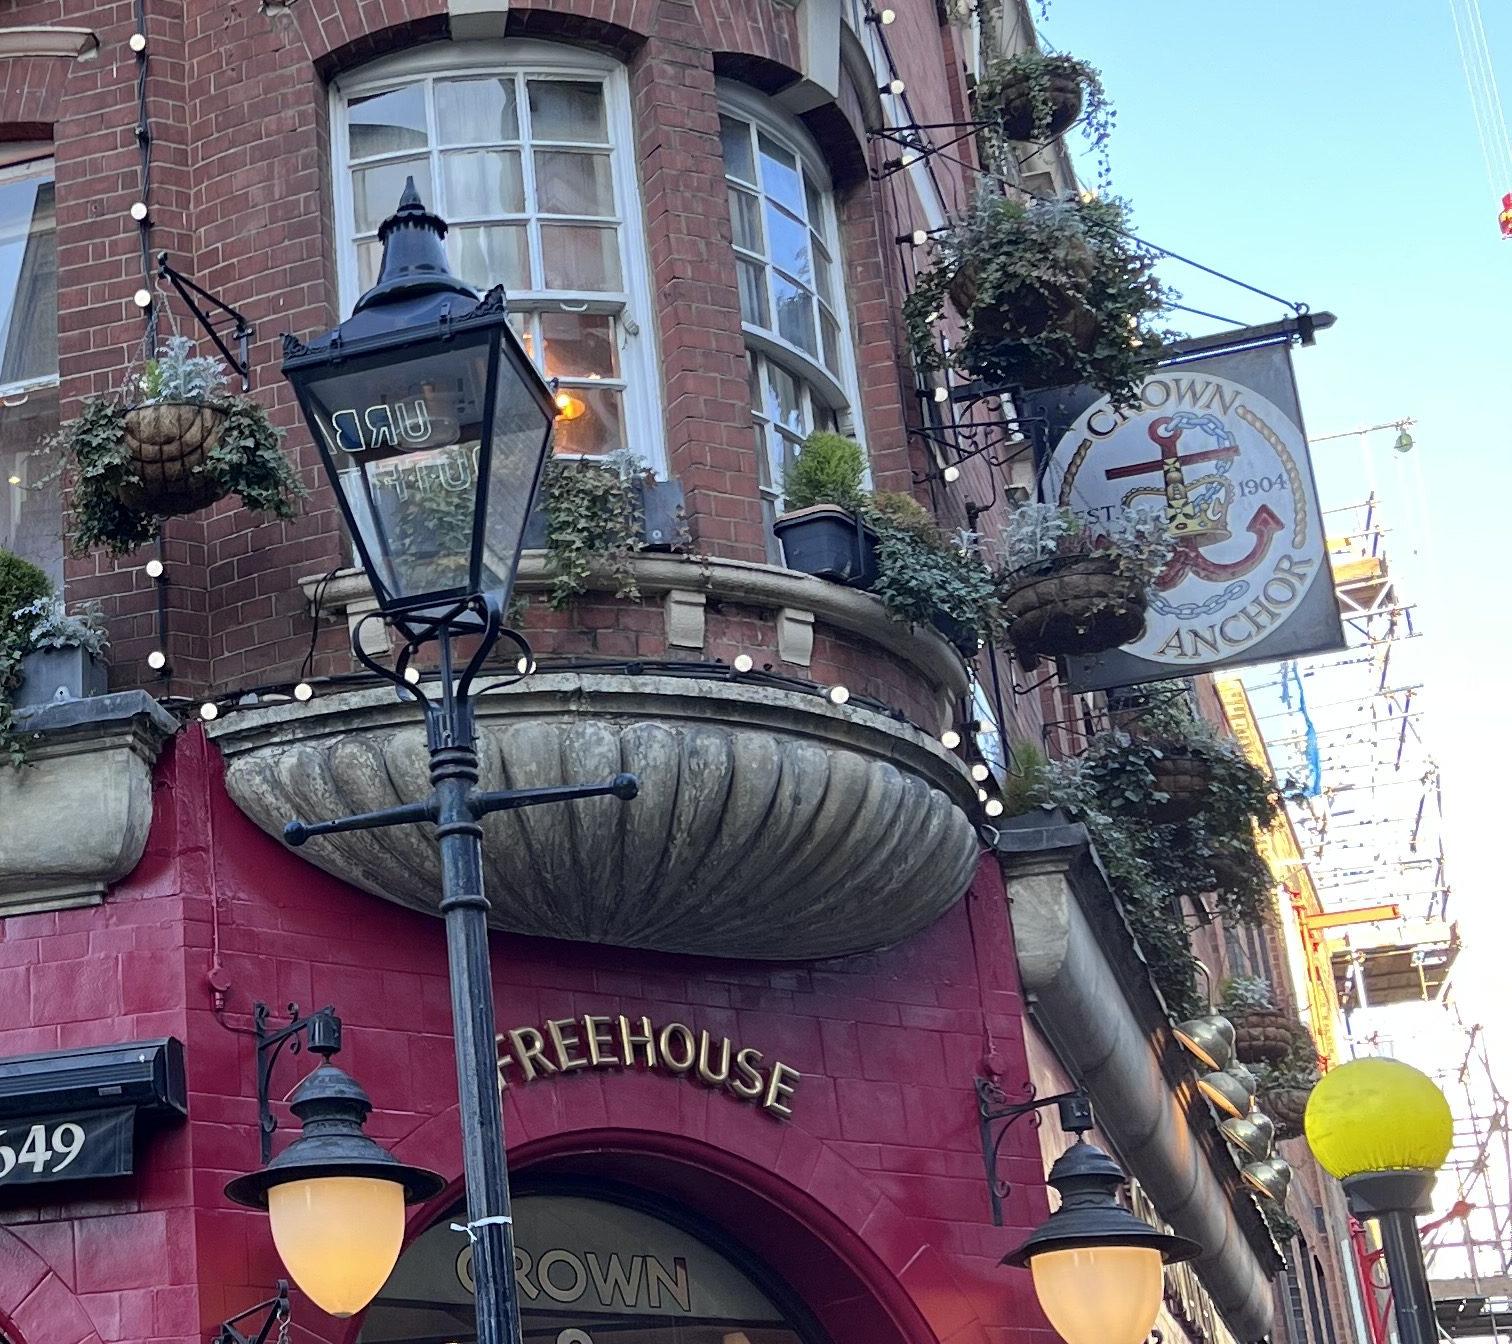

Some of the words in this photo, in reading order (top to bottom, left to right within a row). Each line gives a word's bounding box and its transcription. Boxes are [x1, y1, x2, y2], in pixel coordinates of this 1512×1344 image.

[1237, 473, 1289, 498] 1904
[1154, 553, 1315, 659] ANCHOR
[496, 1013, 801, 1120] FREEHOUSE
